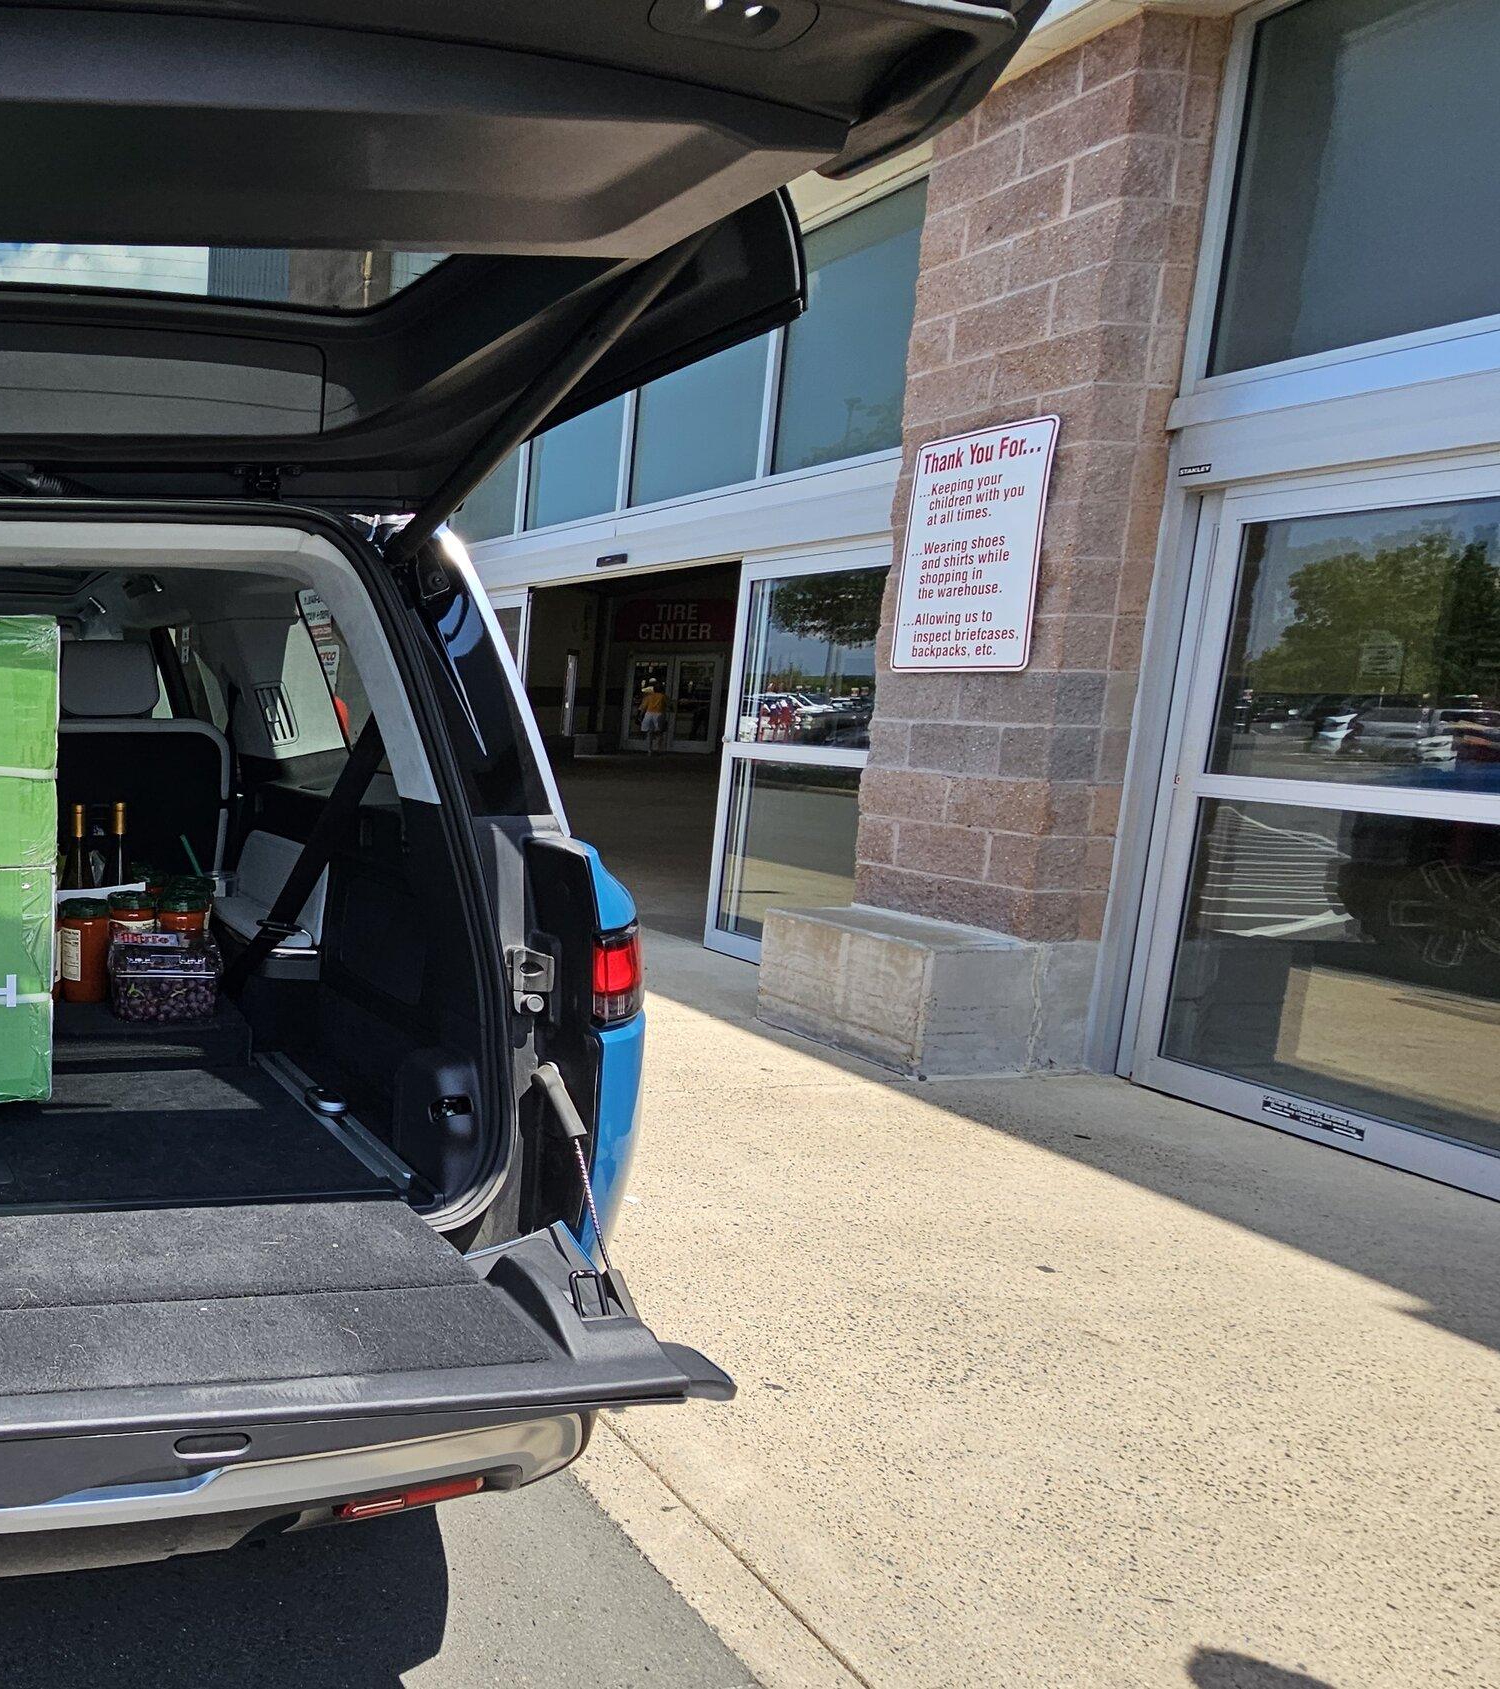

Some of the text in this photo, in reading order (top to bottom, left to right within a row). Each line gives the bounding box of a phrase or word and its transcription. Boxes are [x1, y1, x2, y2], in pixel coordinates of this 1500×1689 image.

[924, 436, 1041, 474] Thank You For...
[1180, 465, 1211, 475] STANLEY
[920, 474, 1003, 498] ...Keeping your
[929, 485, 1025, 511] children with you
[927, 507, 992, 526] at all times.
[911, 535, 1005, 557] ...Wearing shoes
[922, 549, 1010, 570] and shirts while
[920, 567, 983, 585] shopping in
[918, 583, 1002, 599] the warehouse.
[656, 604, 698, 620] TIRE
[903, 610, 992, 626] ...Allowing us to
[639, 623, 711, 640] CENTER
[913, 627, 1019, 644] inspect briefcases,
[912, 643, 996, 659] backpacks, etc.
